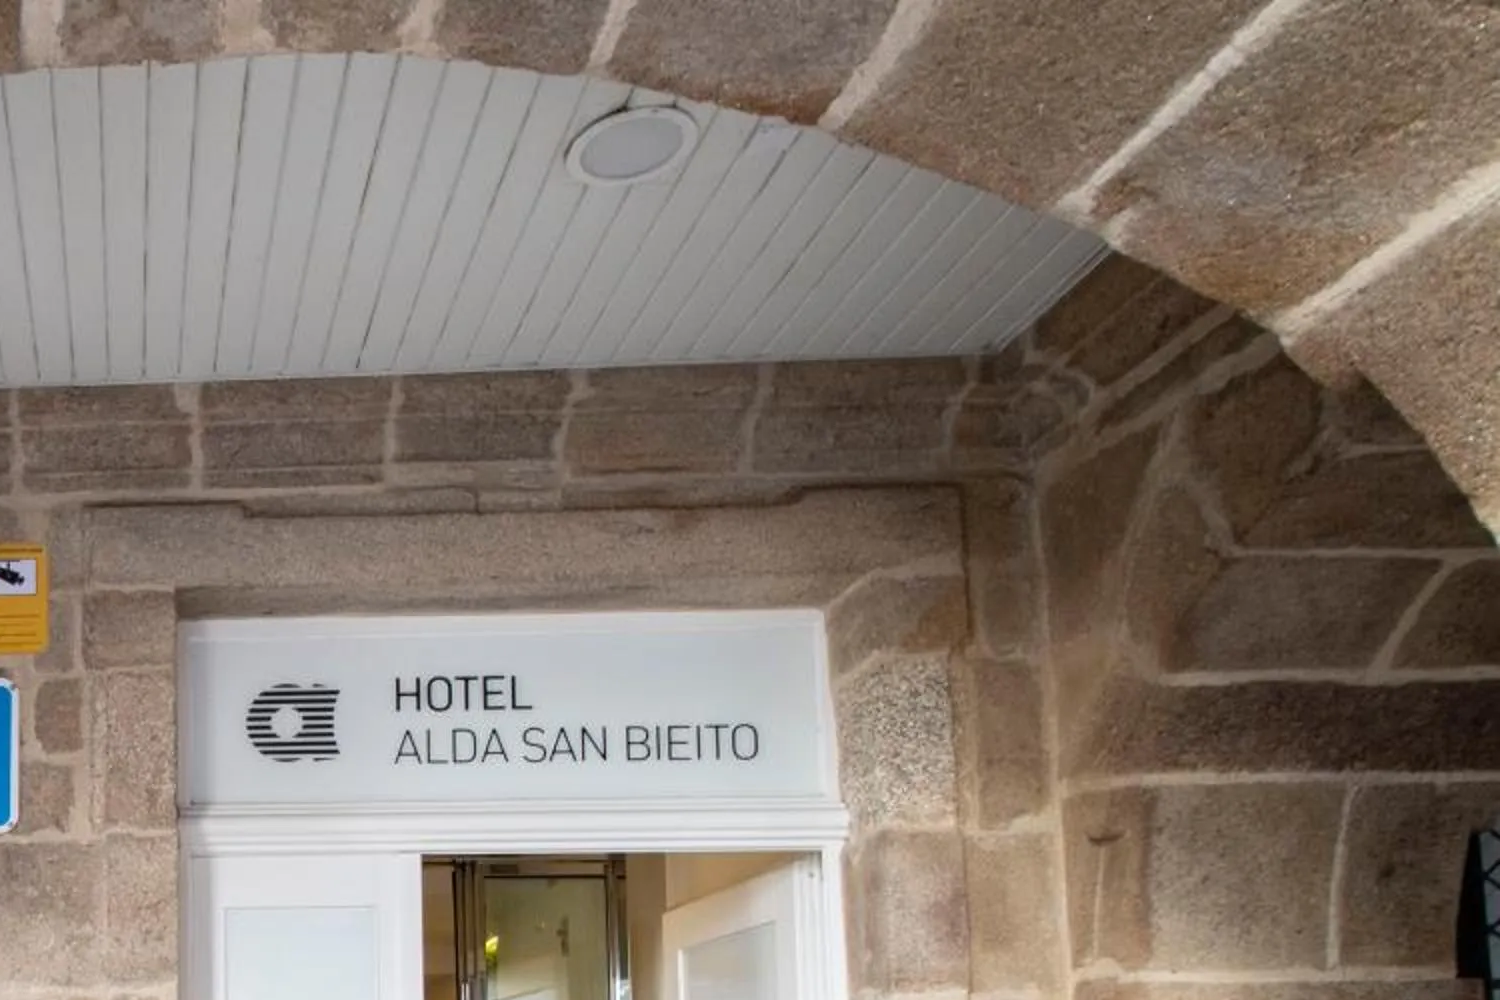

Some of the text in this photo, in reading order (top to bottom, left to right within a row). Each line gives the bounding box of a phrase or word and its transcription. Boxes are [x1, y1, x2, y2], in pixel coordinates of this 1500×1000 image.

[394, 674, 534, 712] HOTEL
[394, 723, 760, 765] ALDA SAN BIEITO
